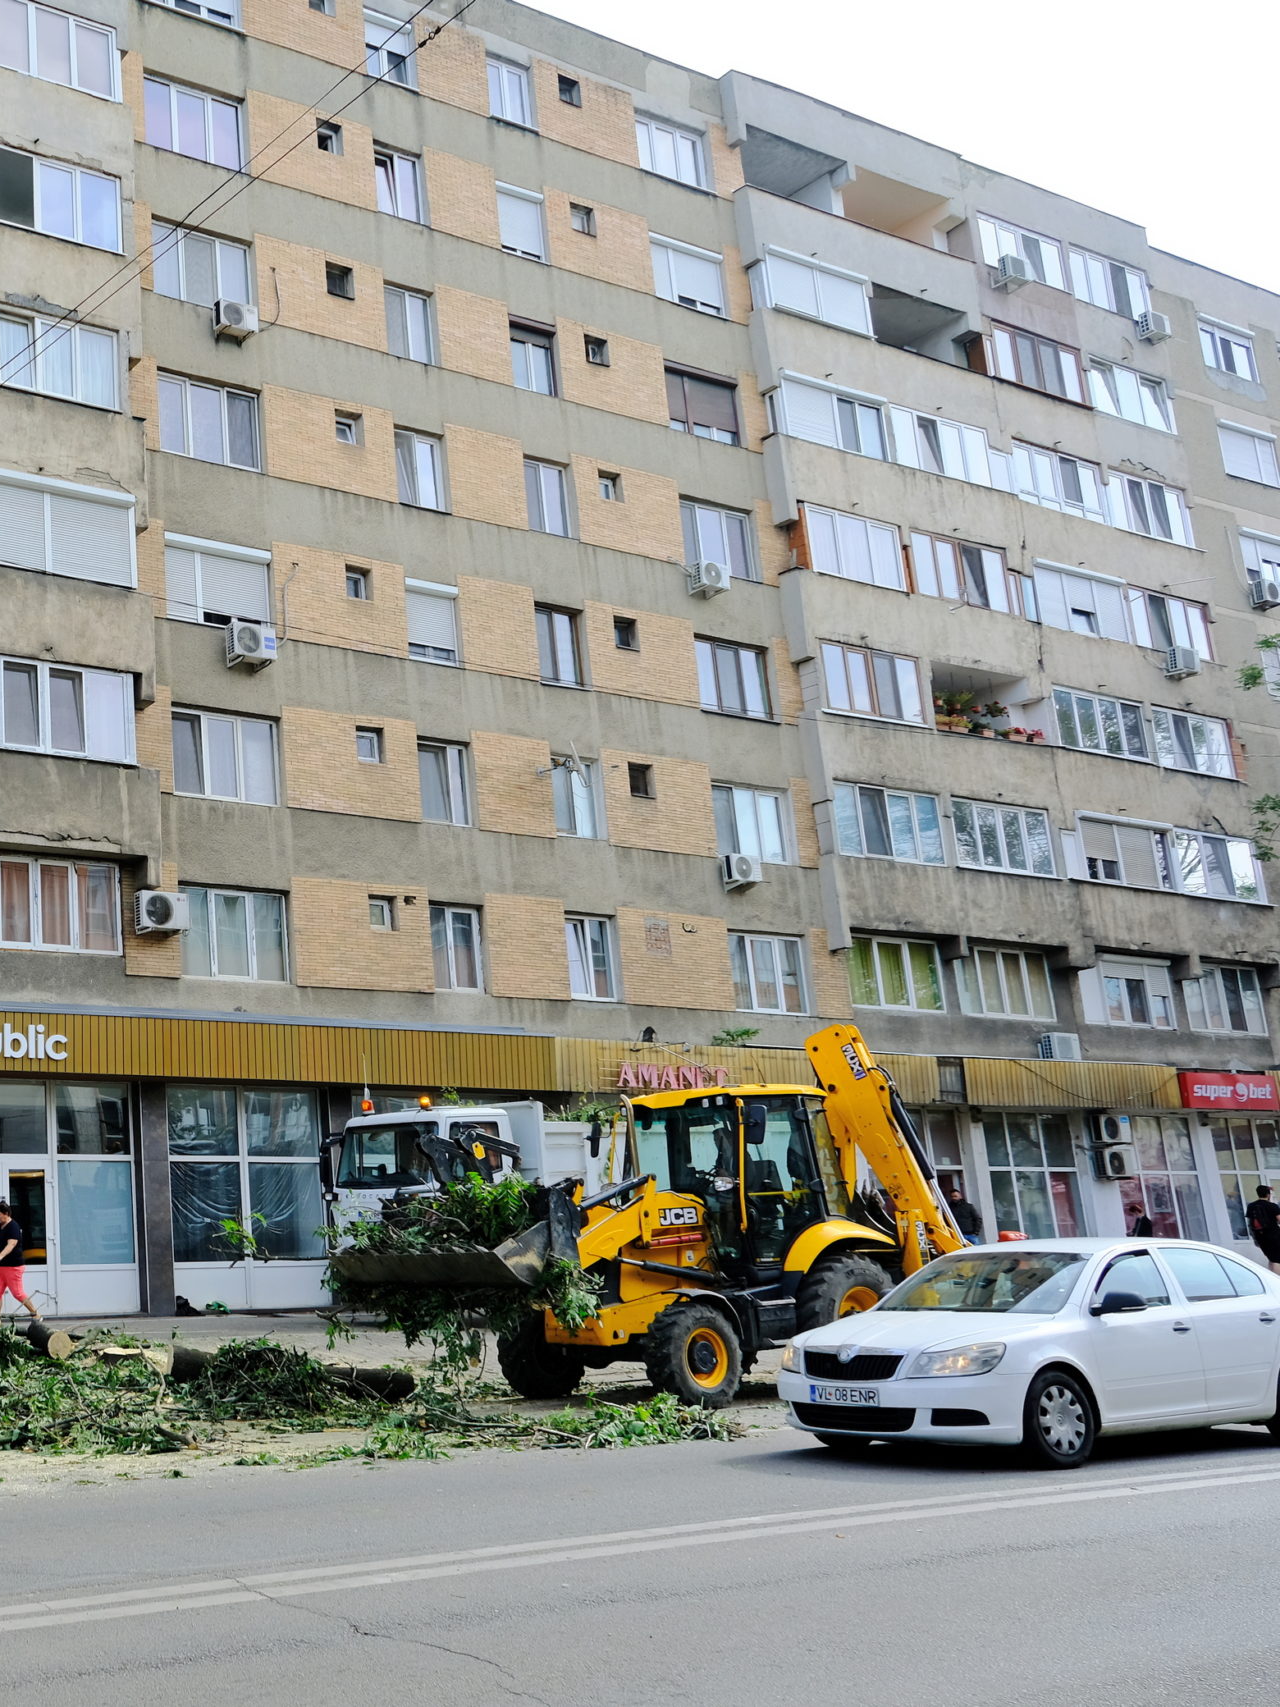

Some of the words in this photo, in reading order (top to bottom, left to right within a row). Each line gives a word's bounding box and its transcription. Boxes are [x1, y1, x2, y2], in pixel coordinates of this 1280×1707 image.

[616, 1062, 729, 1089] AMANET
[1193, 1084, 1234, 1101] super
[1248, 1083, 1272, 1099] bet
[660, 1207, 699, 1226] JCB
[816, 1387, 831, 1401] VL
[834, 1388, 848, 1402] 08
[850, 1389, 877, 1404] ENR
